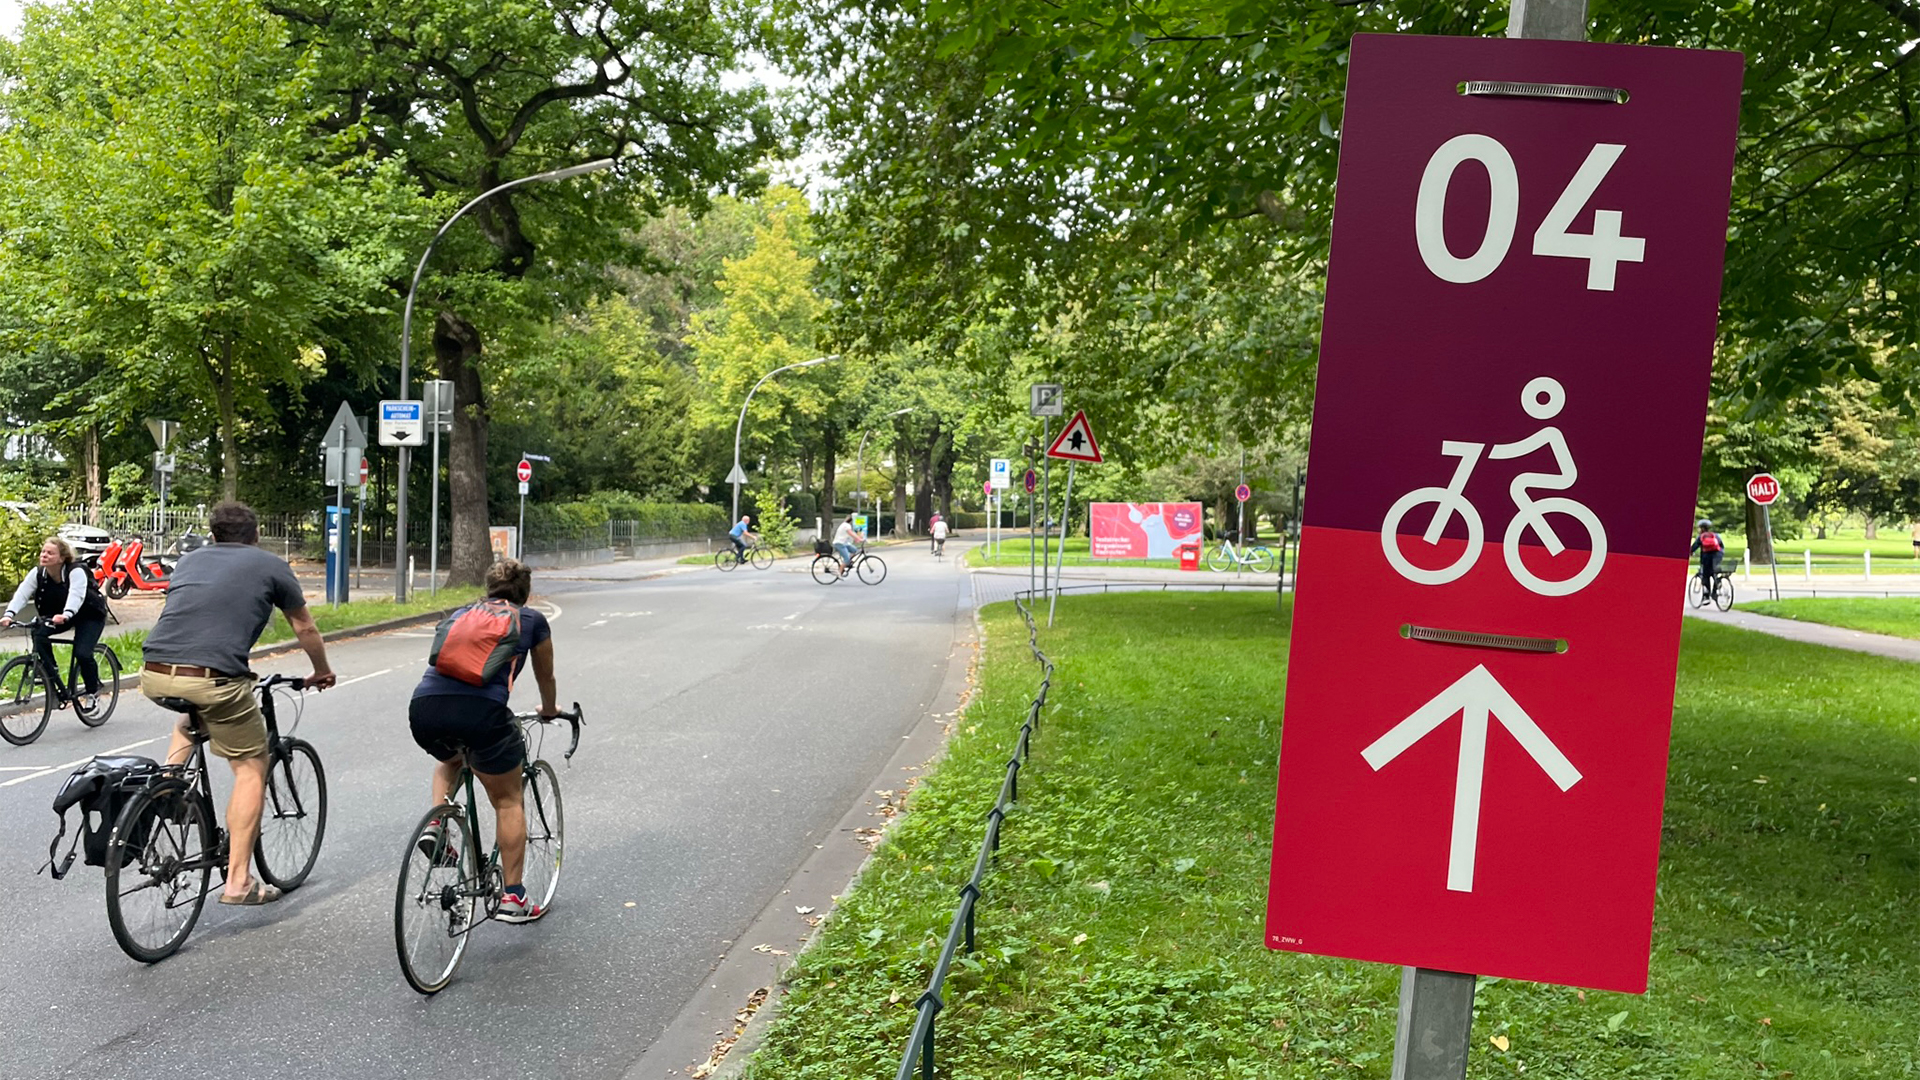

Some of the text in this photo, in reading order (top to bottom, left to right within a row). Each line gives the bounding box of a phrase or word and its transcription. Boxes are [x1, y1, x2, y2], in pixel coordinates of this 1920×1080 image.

[1415, 133, 1646, 291] 04
[1041, 389, 1051, 404] P
[997, 462, 1004, 472] P
[1750, 482, 1775, 497] HALT
